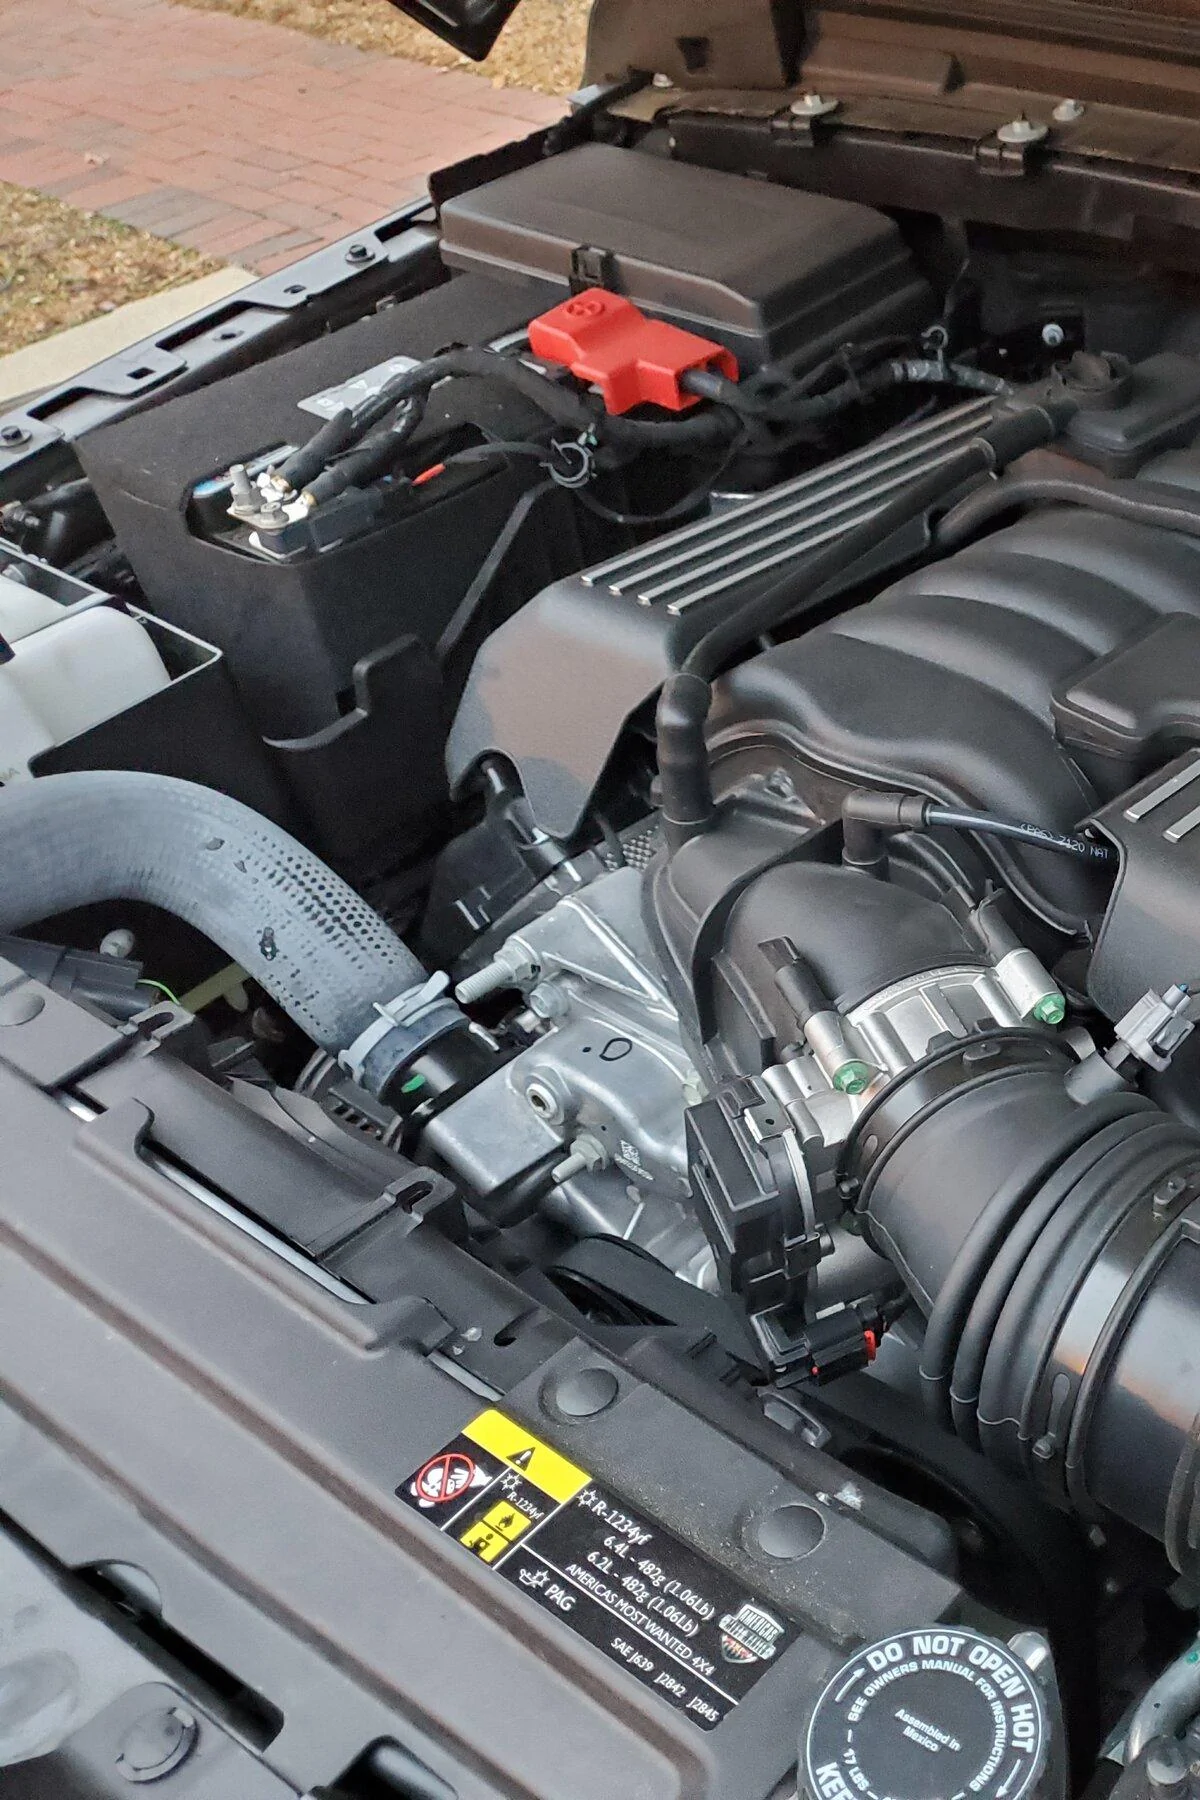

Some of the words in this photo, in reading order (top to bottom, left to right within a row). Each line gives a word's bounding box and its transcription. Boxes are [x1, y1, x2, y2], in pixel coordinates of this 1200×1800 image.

[1090, 846, 1109, 859] NAT
[507, 1491, 545, 1520] R-1234yf
[591, 1500, 653, 1546] R-1234yf
[587, 1551, 613, 1575] 6.2L
[621, 1575, 650, 1603] 482g
[647, 1596, 699, 1637] (1.06Lb)
[603, 1536, 629, 1559] 6.4L
[638, 1560, 667, 1587] 482g
[663, 1580, 715, 1621] (1.06Lb)
[544, 1584, 576, 1611] PAG
[565, 1563, 619, 1604] AMERICAS
[615, 1600, 647, 1625] MOST
[645, 1619, 693, 1659] WANTED
[692, 1656, 716, 1676] 4X4
[739, 1608, 779, 1642] AMERICAS
[610, 1637, 634, 1657] SAE
[626, 1651, 655, 1672] J639
[653, 1671, 687, 1698] J2842
[685, 1696, 719, 1722] J2845
[863, 1661, 918, 1697] OWNERS
[921, 1659, 976, 1682] MANUAL
[866, 1642, 904, 1673] DO
[912, 1635, 966, 1657] NOT
[968, 1645, 1026, 1700] OPEN
[1010, 1703, 1035, 1753] HOT
[974, 1677, 997, 1701] FOR
[847, 1696, 868, 1722] SEE
[894, 1708, 950, 1745] Assembled
[949, 1738, 961, 1751] in
[902, 1726, 941, 1752] Mexico
[969, 1700, 1007, 1792] INSTRUCTIONS
[849, 1766, 870, 1791] LBS
